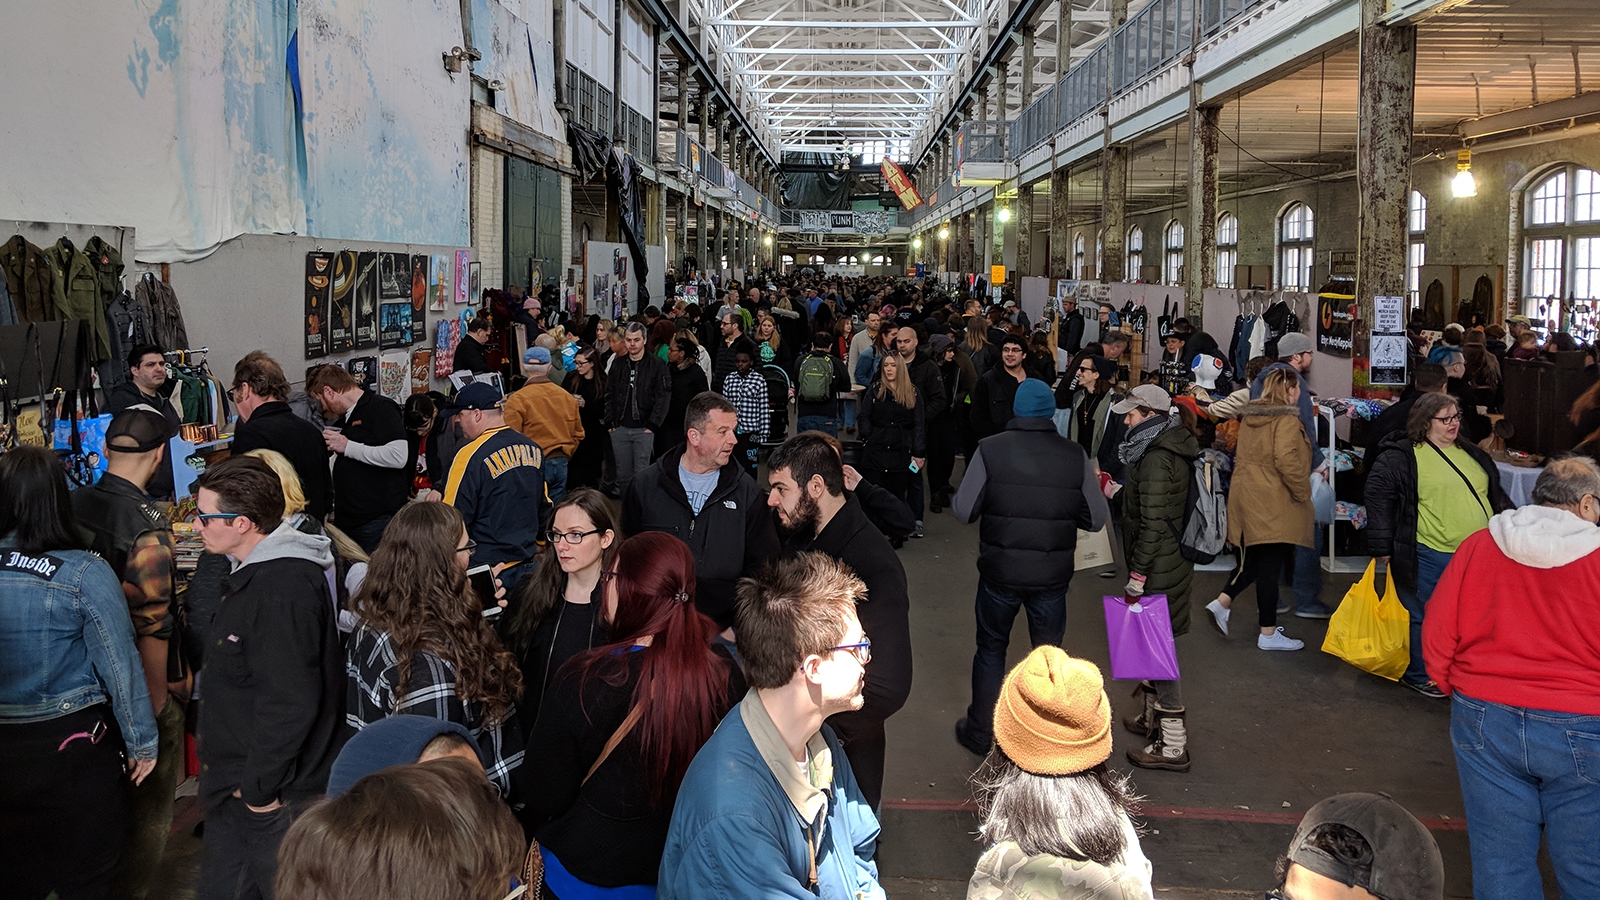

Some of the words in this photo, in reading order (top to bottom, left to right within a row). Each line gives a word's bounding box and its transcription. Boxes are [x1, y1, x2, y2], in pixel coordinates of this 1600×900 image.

[882, 158, 921, 210] ATM
[831, 215, 851, 226] PUNK
[484, 444, 541, 479] ANNAPOLIS
[5, 551, 57, 576] Inside
